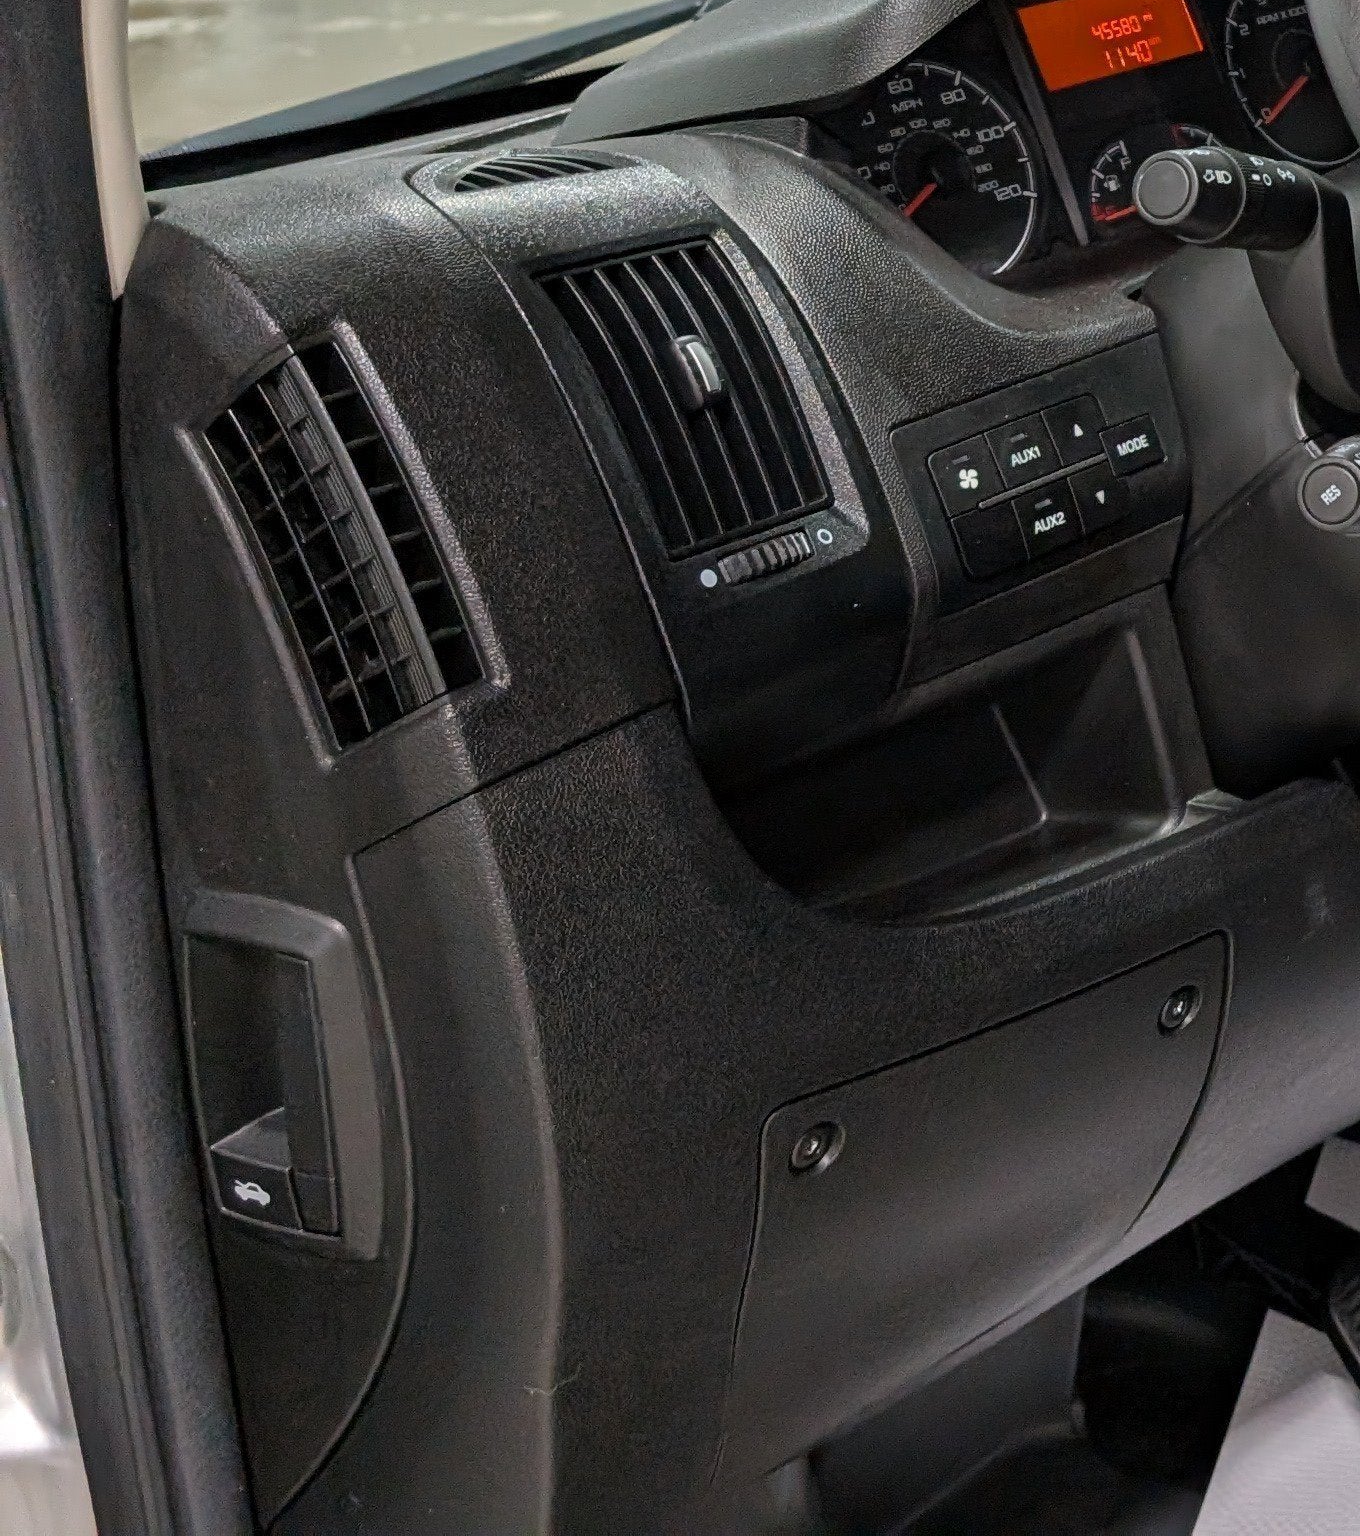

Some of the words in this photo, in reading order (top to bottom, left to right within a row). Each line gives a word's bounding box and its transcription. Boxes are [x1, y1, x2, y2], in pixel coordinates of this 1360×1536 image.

[1091, 15, 1142, 40] 45580
[887, 78, 913, 94] 60
[892, 98, 923, 114] MPH
[940, 88, 966, 105] 80
[976, 125, 1004, 143] 100
[994, 183, 1022, 201] 120
[1116, 434, 1150, 457] MODE
[1010, 445, 1042, 468] AUX1
[1320, 484, 1342, 506] RES
[1034, 511, 1067, 535] AUX2
